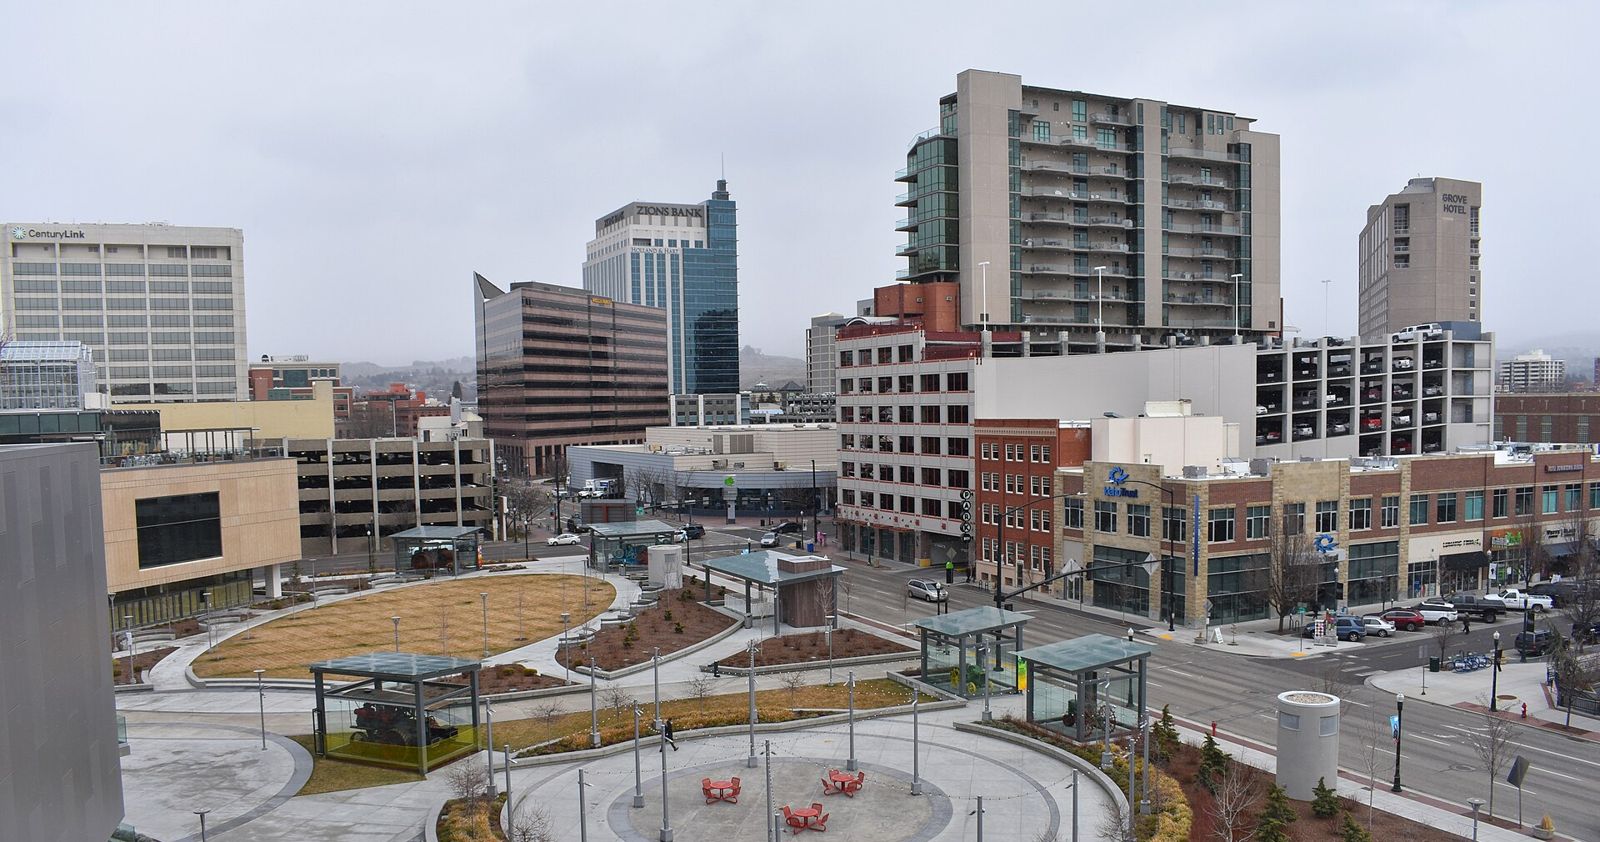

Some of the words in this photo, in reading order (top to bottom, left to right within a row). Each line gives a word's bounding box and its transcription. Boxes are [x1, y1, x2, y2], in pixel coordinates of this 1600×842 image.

[1442, 193, 1468, 204] GROVE
[636, 205, 669, 216] ZIONS
[671, 206, 703, 218] BANK
[1443, 204, 1467, 214] HOTEL
[28, 229, 85, 239] CenturyLink
[961, 490, 971, 532] PARK
